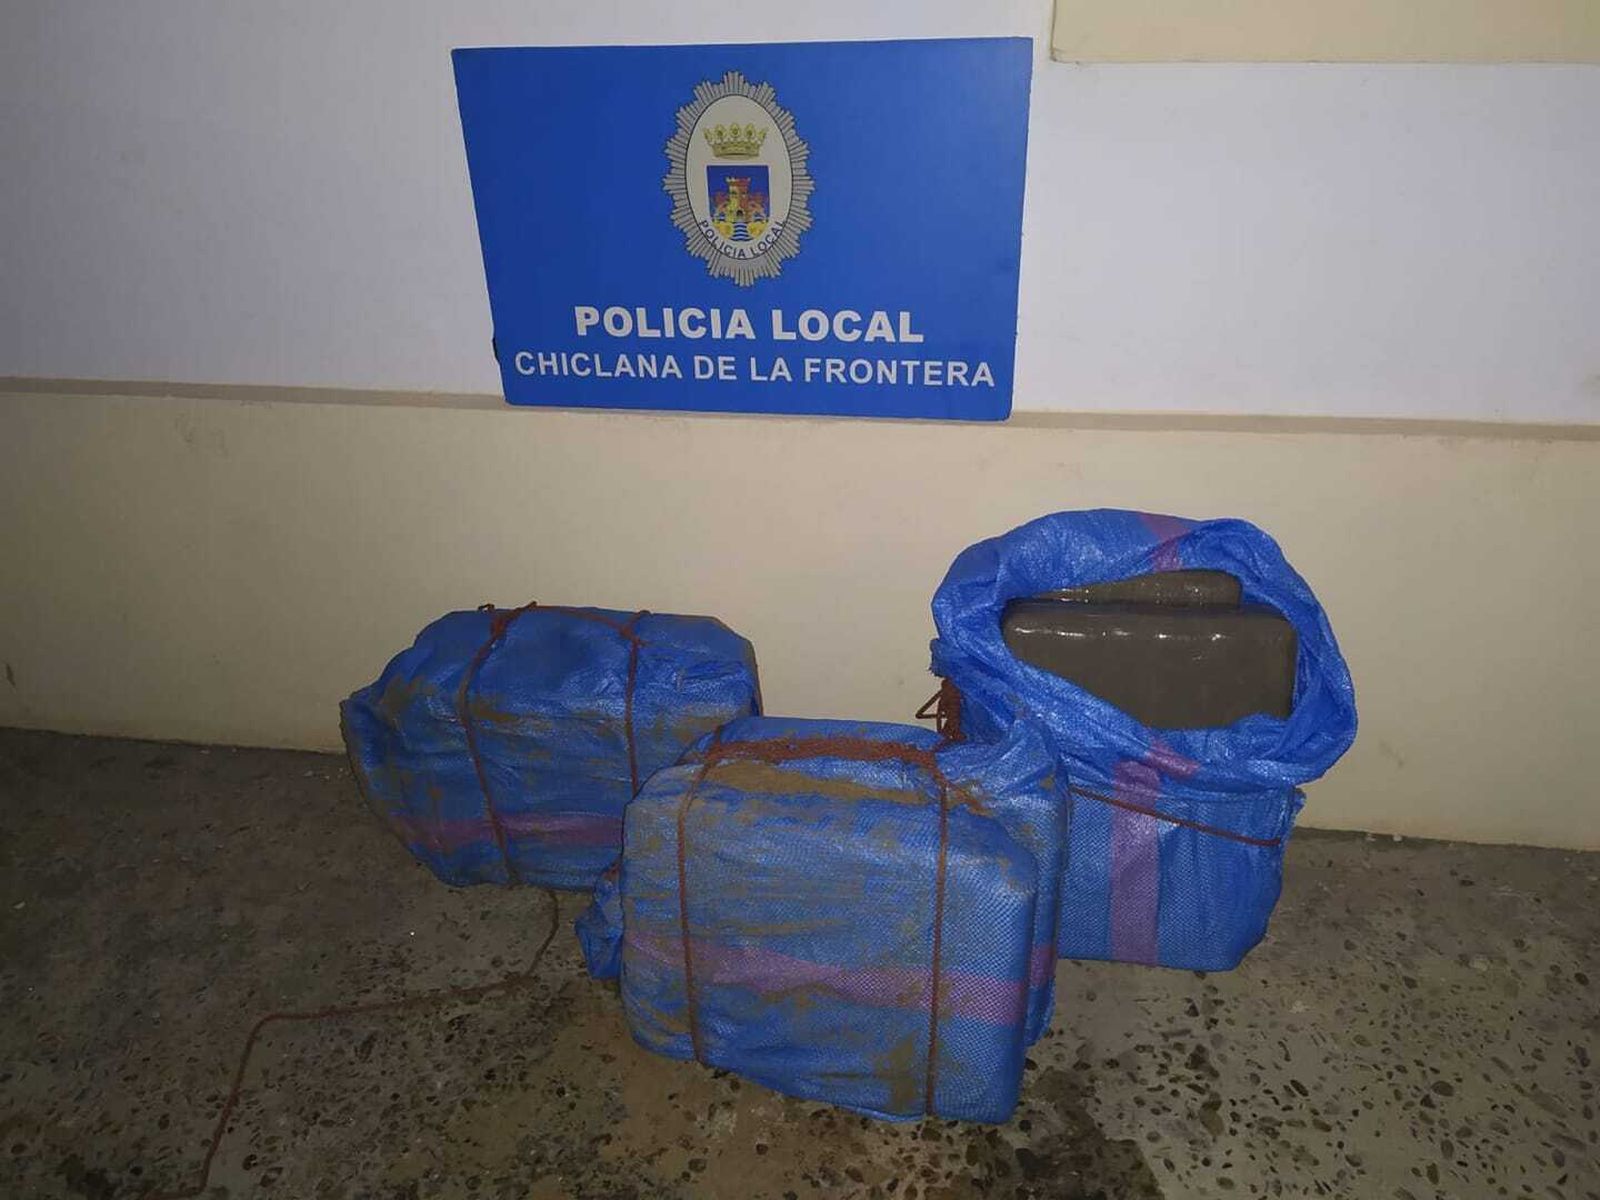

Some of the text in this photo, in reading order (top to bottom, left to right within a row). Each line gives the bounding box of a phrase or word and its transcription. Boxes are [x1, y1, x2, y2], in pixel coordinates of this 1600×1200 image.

[700, 220, 784, 258] POLICIA LOCAL
[574, 305, 925, 344] POLICIA LOCAL
[514, 351, 995, 388] CHICLANA DE LA FRONTERA
